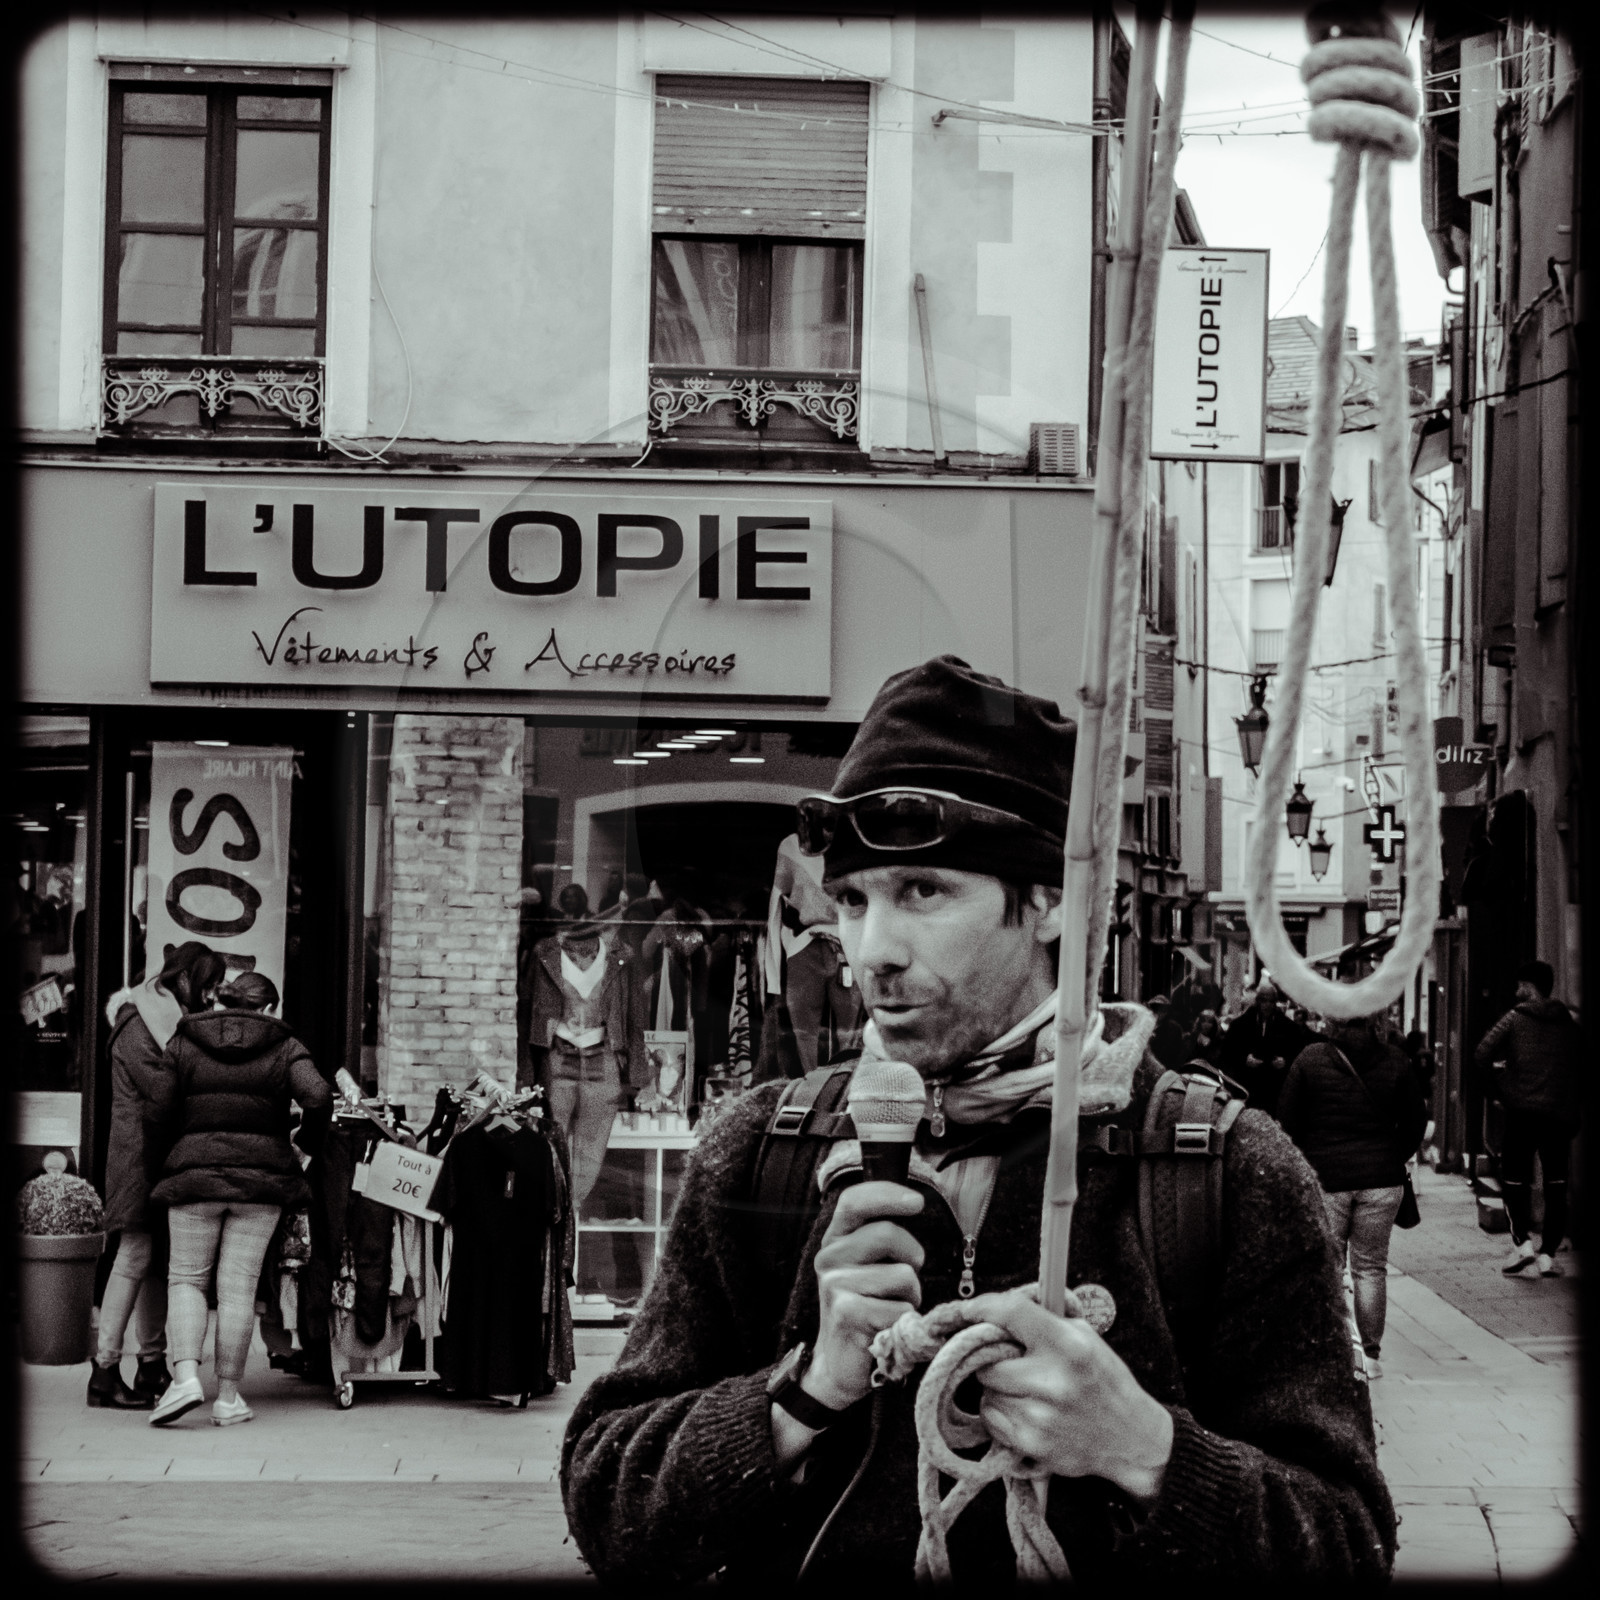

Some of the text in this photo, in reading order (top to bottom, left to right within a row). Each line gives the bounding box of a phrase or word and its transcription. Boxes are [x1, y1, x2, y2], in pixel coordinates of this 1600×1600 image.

[1196, 278, 1222, 428] L'UTOPIE
[183, 500, 812, 602] L'UTOPIE
[252, 607, 736, 677] Vêtements & Accessoires
[392, 1178, 422, 1199] 20€
[397, 1155, 432, 1176] Tout à
